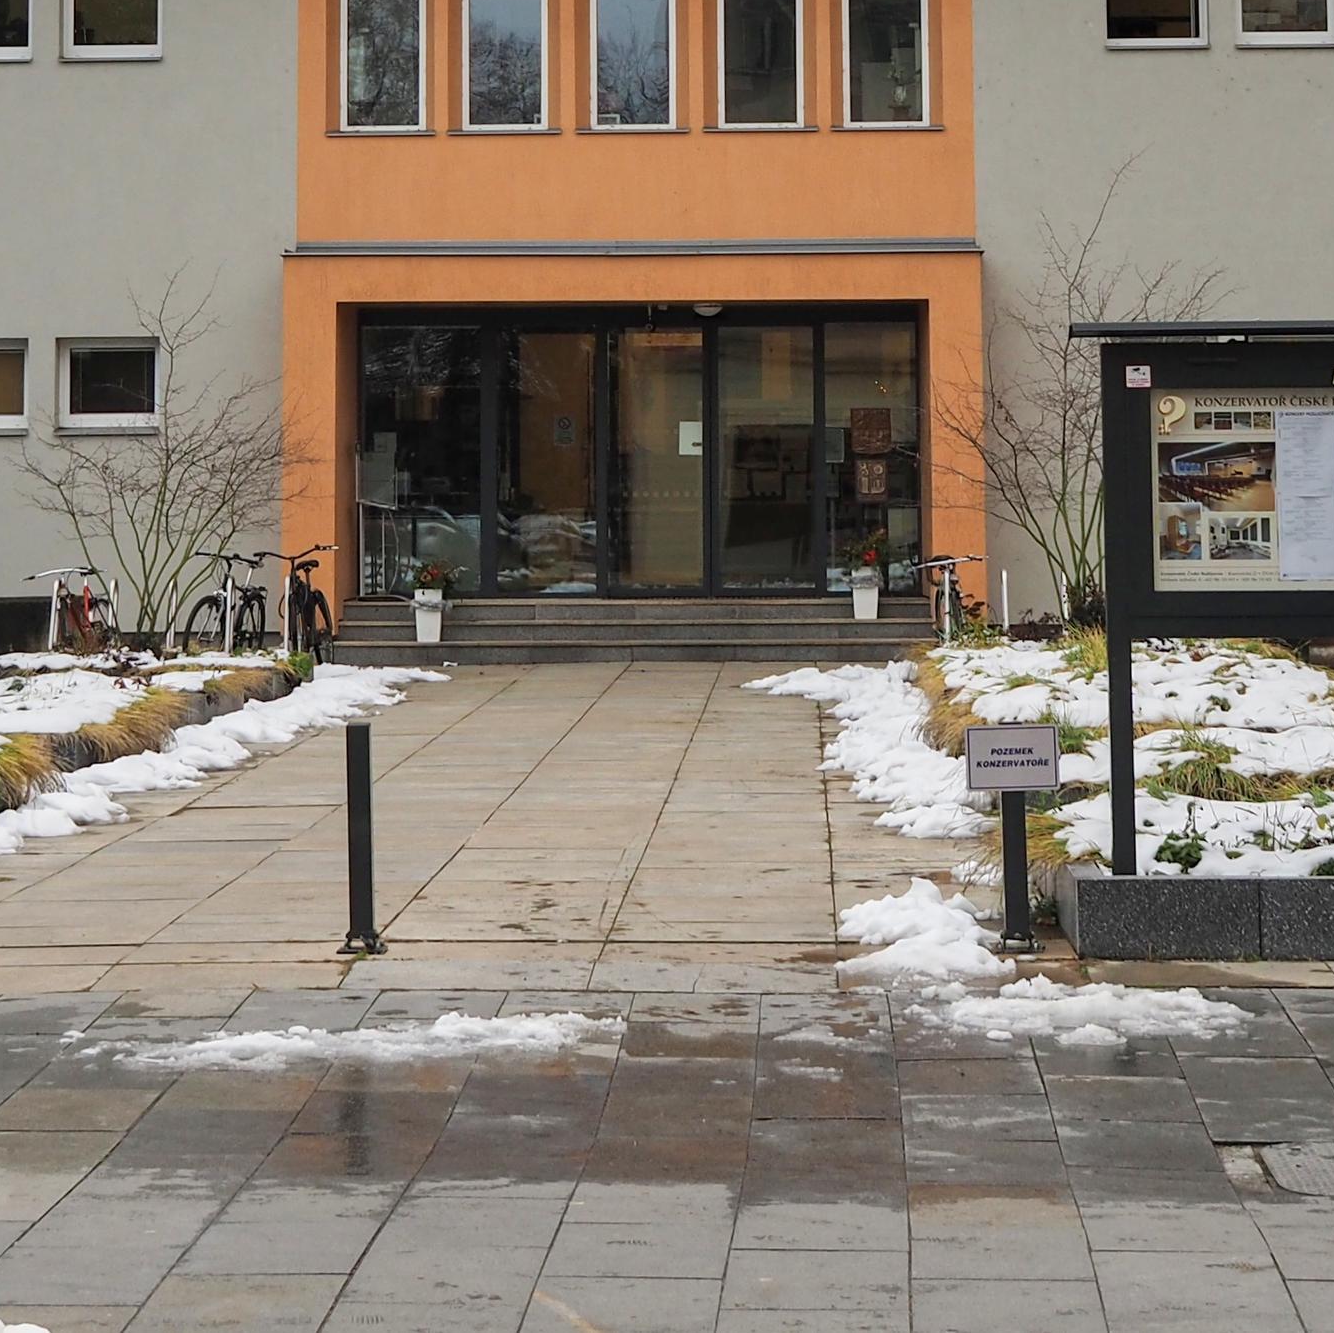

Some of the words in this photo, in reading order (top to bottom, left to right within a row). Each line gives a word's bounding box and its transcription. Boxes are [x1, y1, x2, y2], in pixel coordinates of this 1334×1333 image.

[1194, 395, 1287, 407] KONZERVATOŘ
[1290, 394, 1328, 407] ČESKÉ
[990, 747, 1034, 756] POZEMEK
[976, 758, 1049, 768] KONZERVATOŘE
